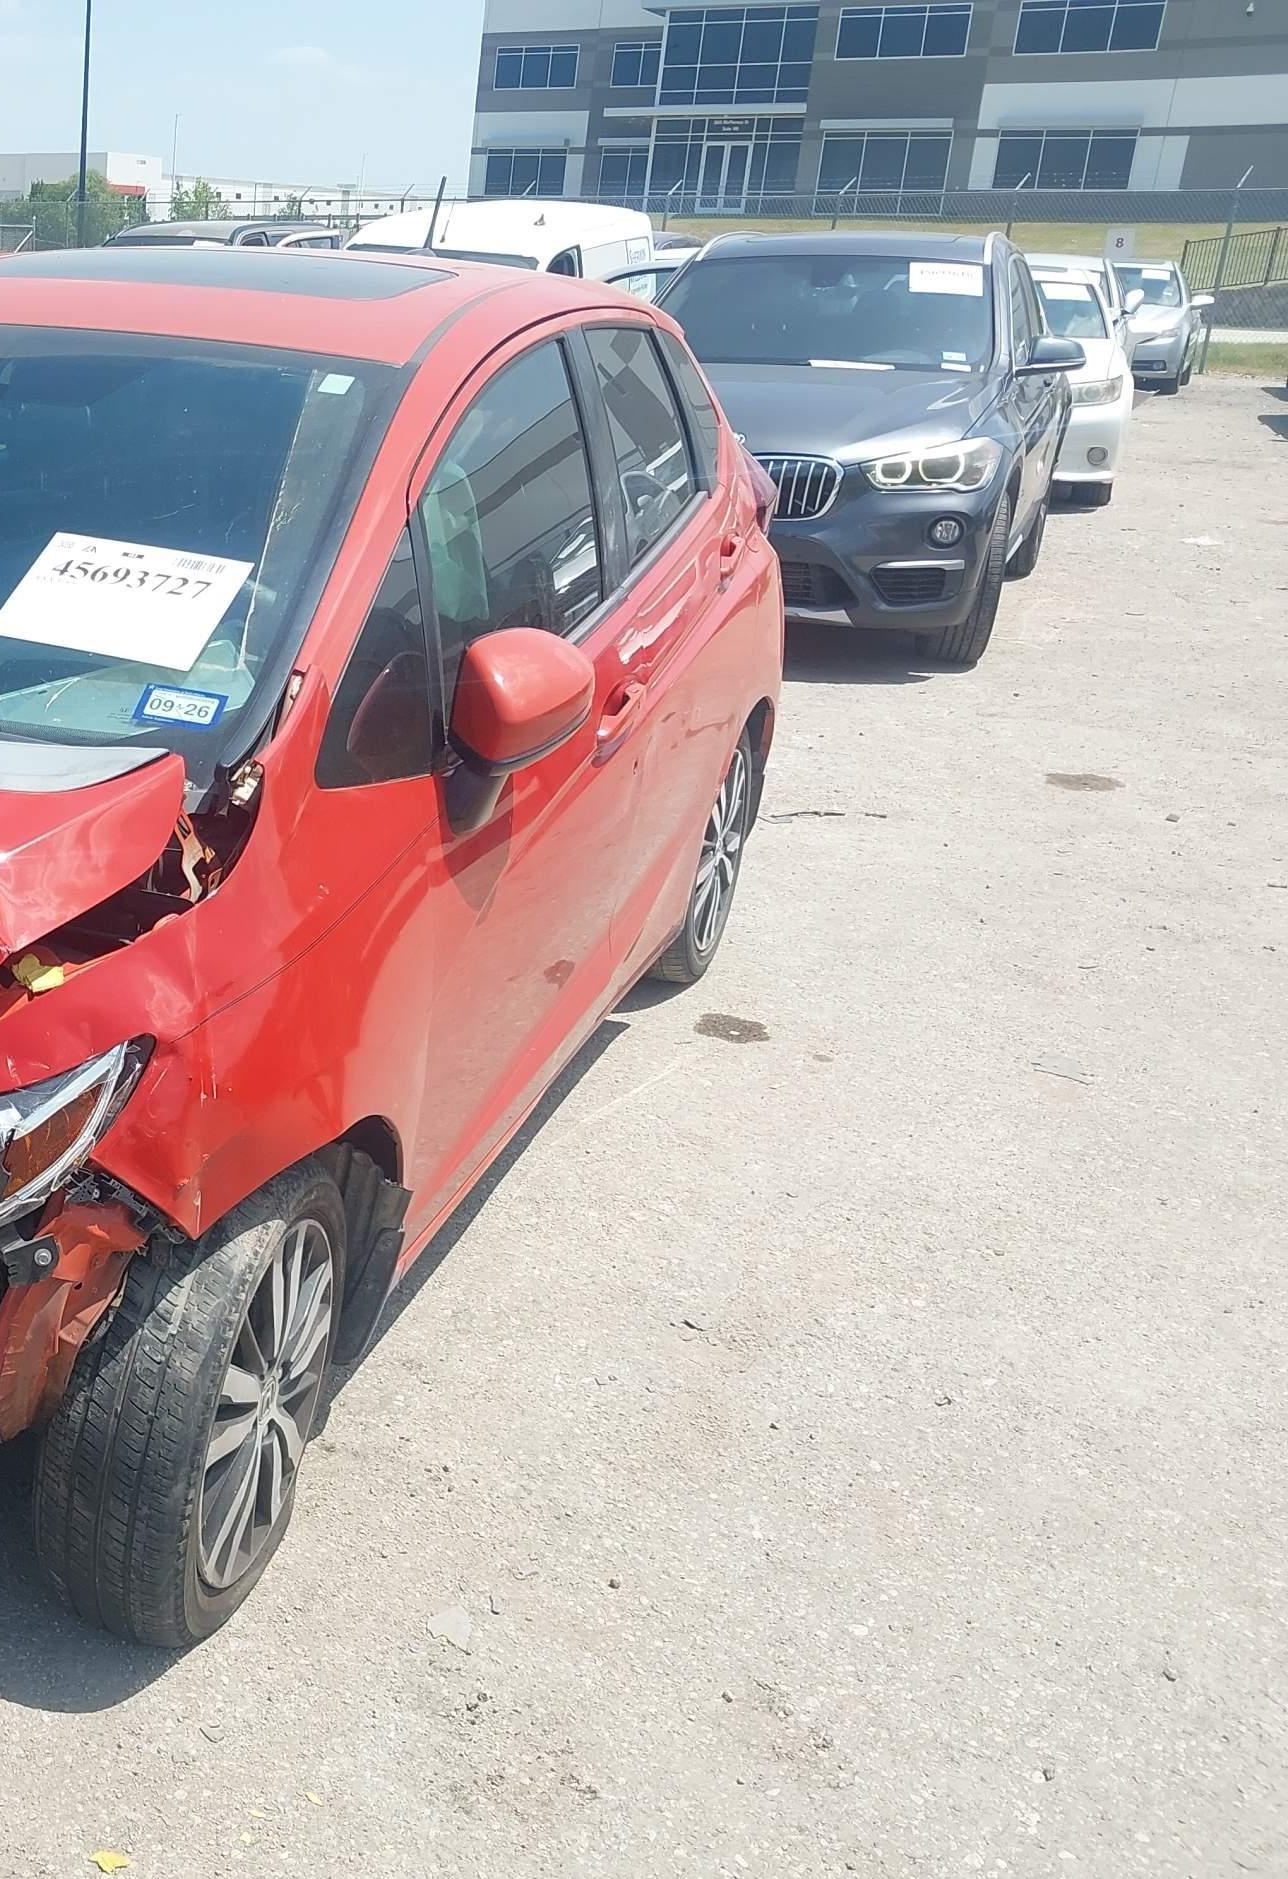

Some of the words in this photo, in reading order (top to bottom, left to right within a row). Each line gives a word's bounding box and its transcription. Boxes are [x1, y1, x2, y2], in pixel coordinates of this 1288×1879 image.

[1115, 237, 1125, 249] 8
[52, 559, 213, 600] 45693727
[149, 698, 175, 713] 09
[183, 703, 210, 718] 26
